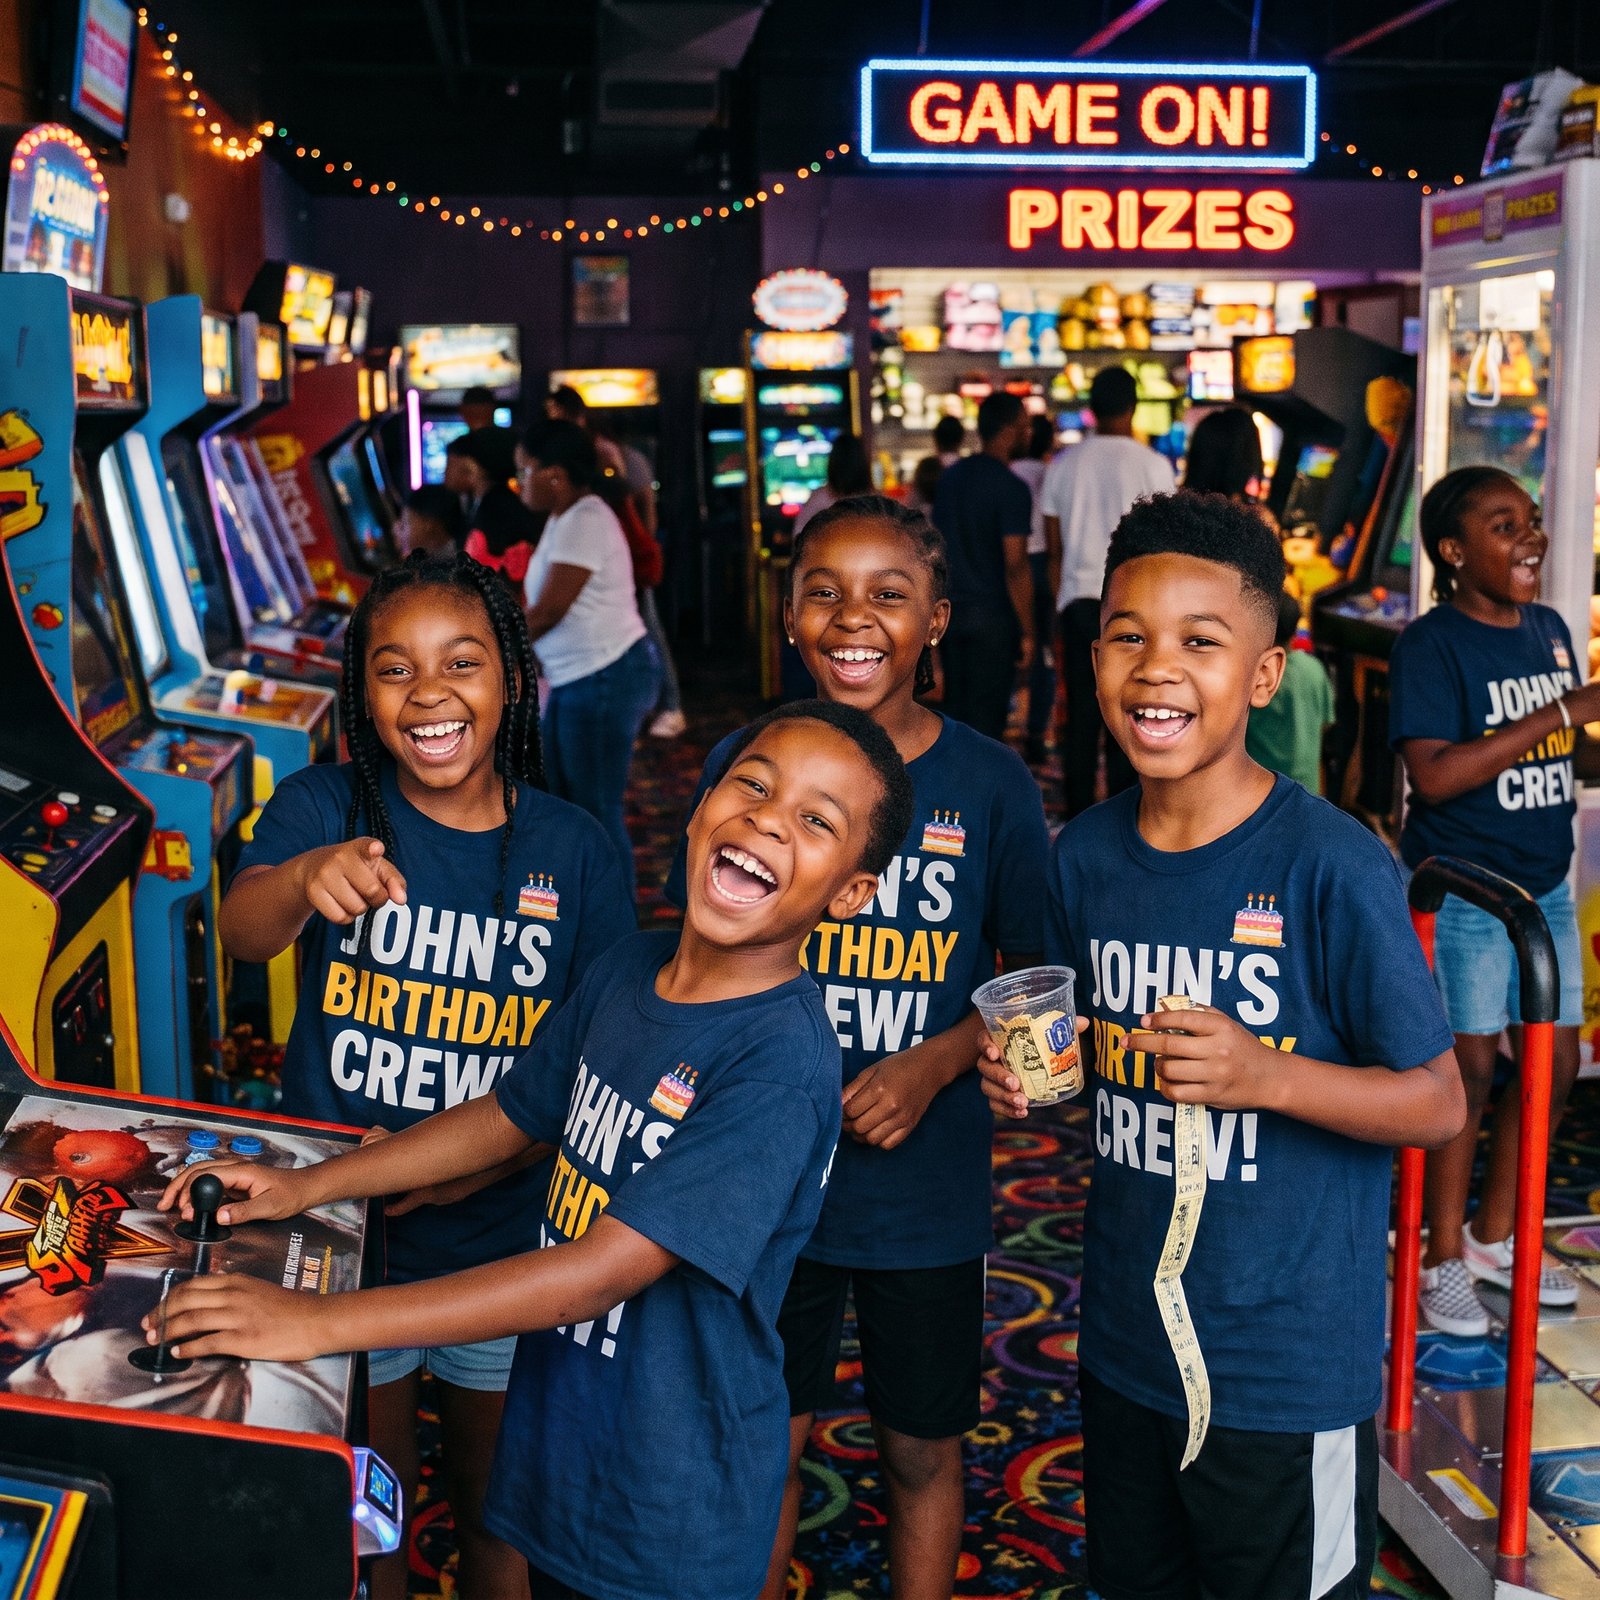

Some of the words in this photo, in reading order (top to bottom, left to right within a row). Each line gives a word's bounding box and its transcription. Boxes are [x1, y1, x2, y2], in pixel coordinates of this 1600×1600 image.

[909, 82, 1119, 144] GAME
[1140, 86, 1270, 146] ON!
[1008, 189, 1295, 250] PRIZES
[859, 855, 956, 922] N'S
[798, 921, 959, 982] THDAY
[1090, 939, 1280, 1026] JOHN'S
[322, 961, 552, 1047] BIRTHDAY
[824, 984, 930, 1052] EW!
[1096, 1088, 1258, 1182] CREW!
